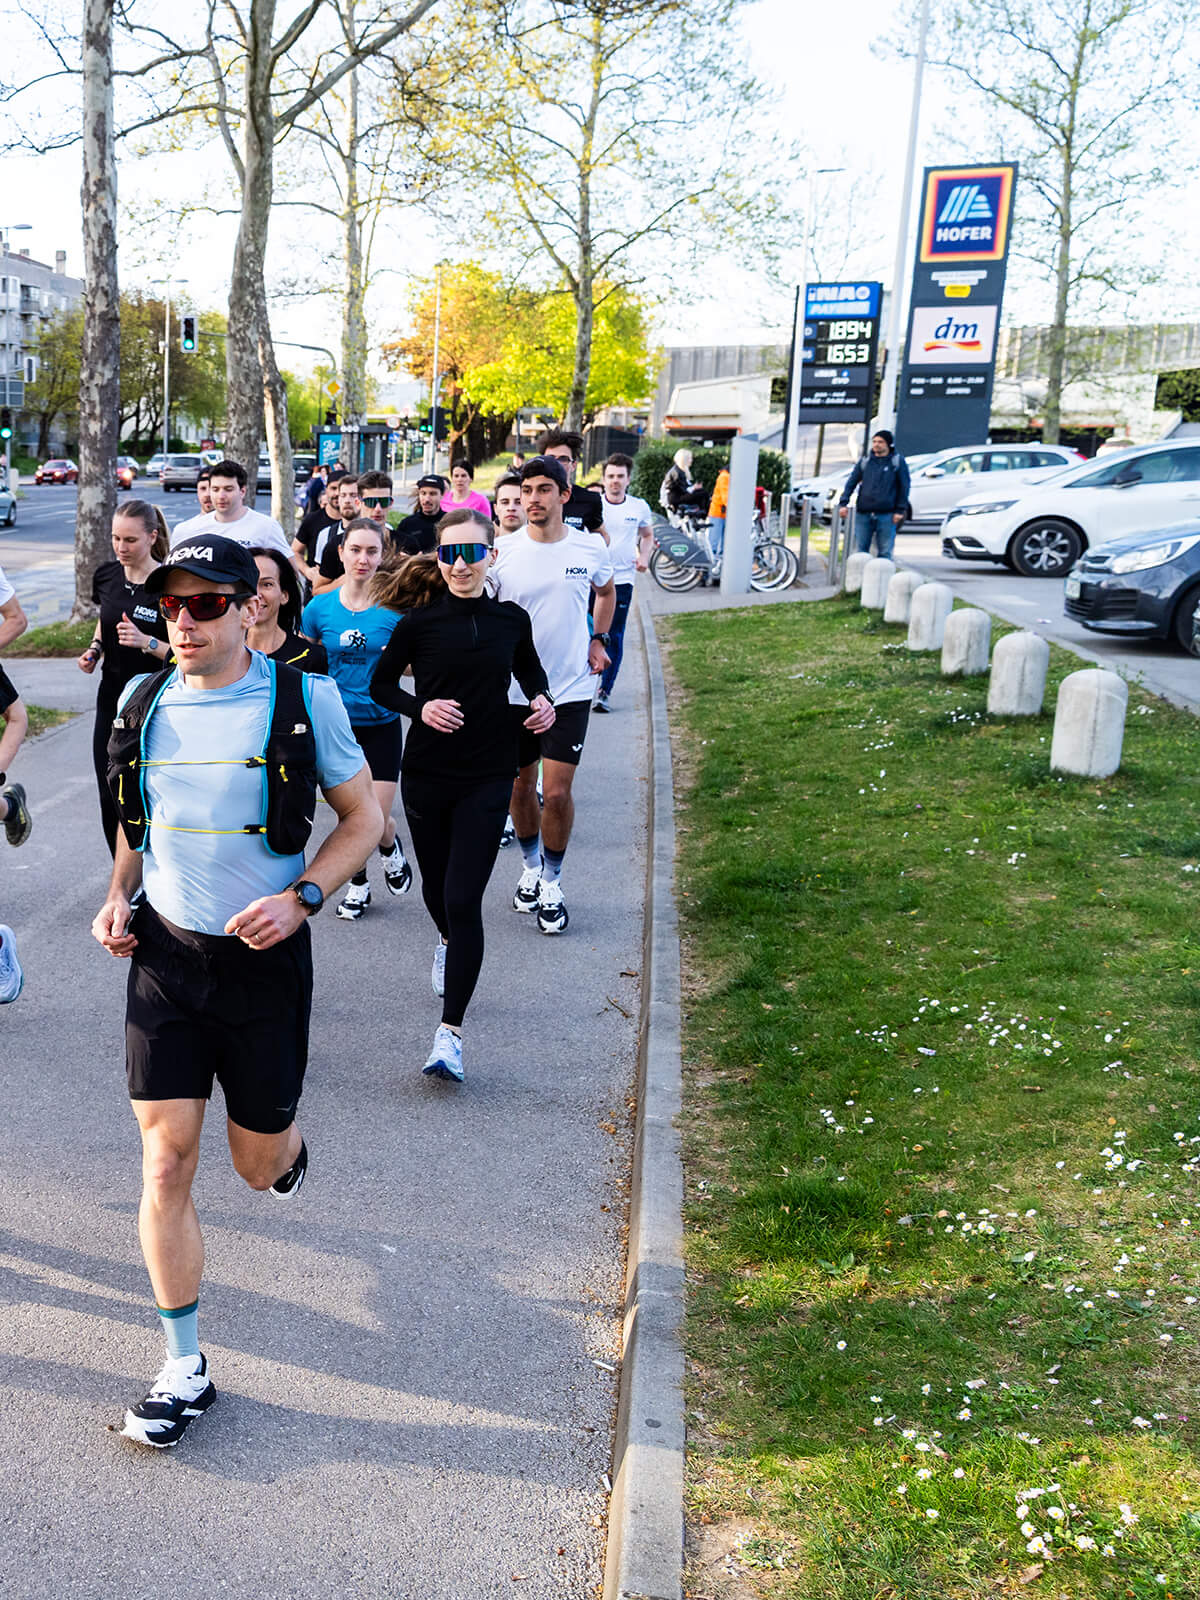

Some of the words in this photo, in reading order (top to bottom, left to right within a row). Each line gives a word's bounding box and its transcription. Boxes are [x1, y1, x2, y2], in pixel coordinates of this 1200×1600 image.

[936, 226, 992, 242] HOFER
[934, 317, 978, 339] dm
[166, 546, 213, 565] HOKA
[565, 567, 588, 575] HOKA
[135, 605, 158, 618] HOKA
